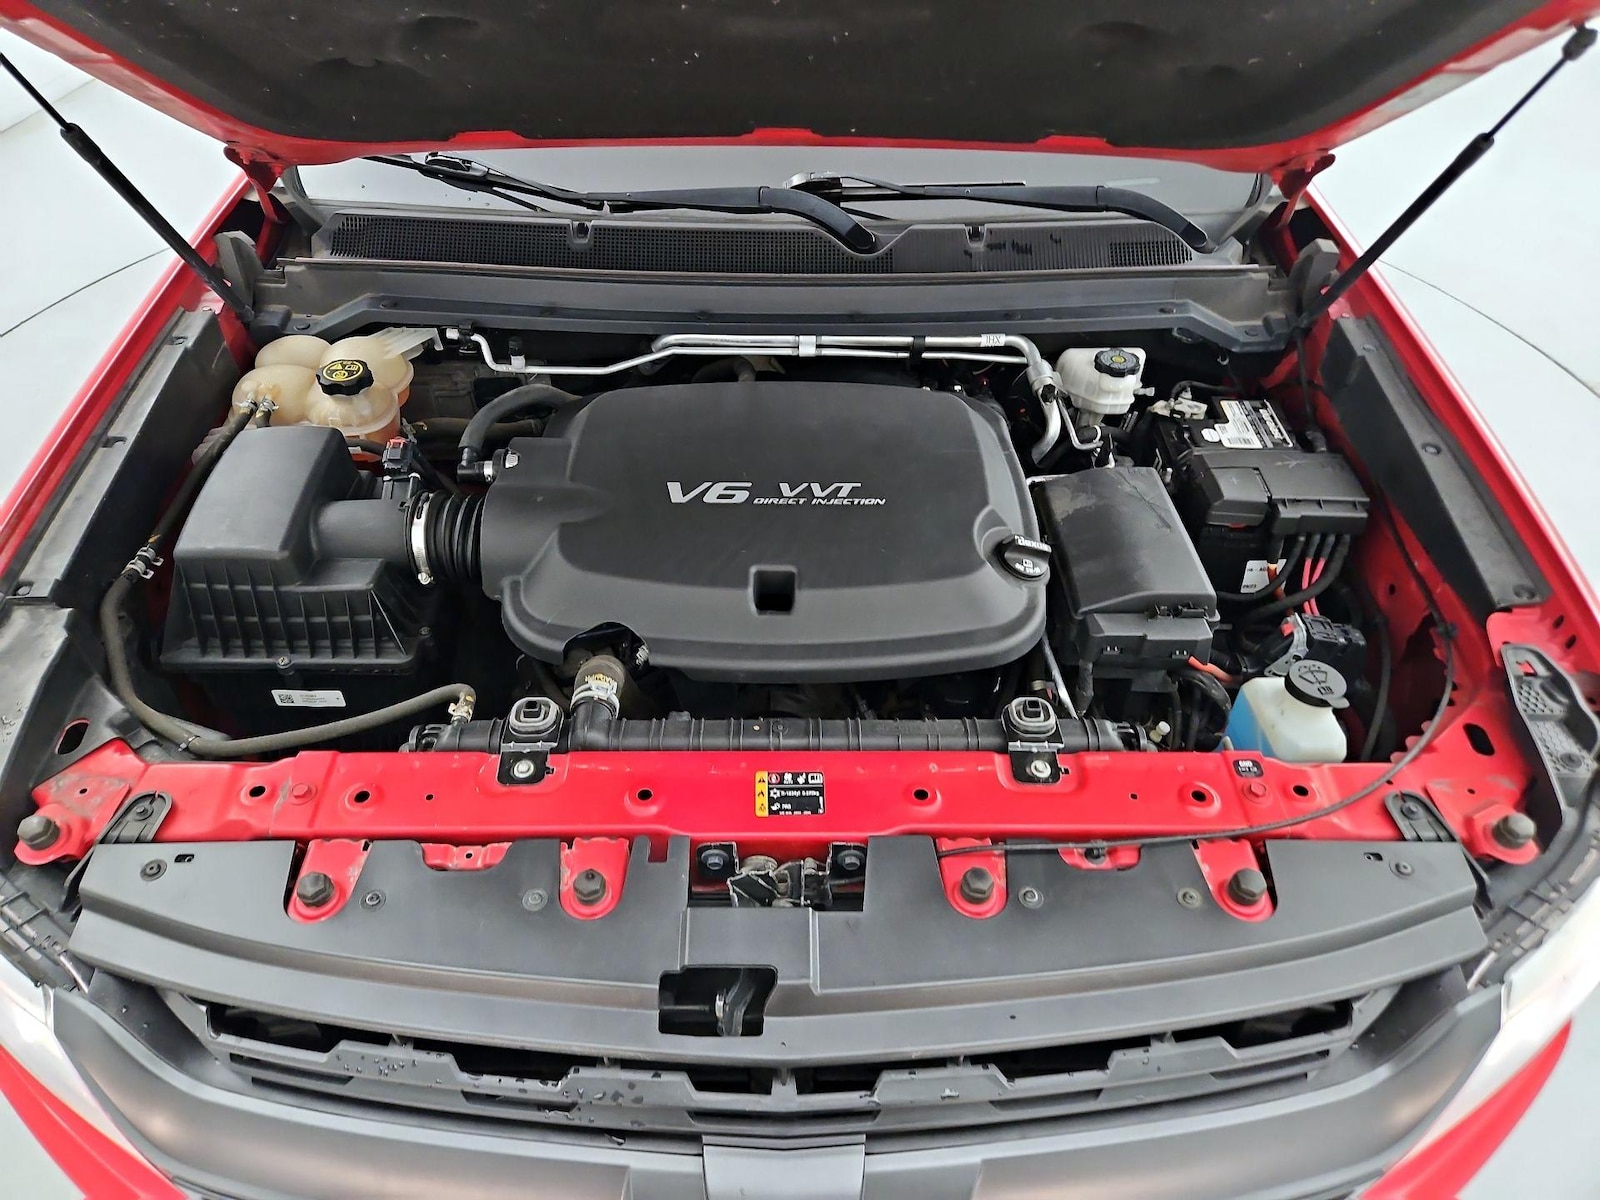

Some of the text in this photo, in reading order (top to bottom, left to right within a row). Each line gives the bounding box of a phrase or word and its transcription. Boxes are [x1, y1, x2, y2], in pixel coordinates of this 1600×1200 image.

[666, 481, 862, 504] V6 VVT
[753, 498, 887, 506] DIRECT INJECTION
